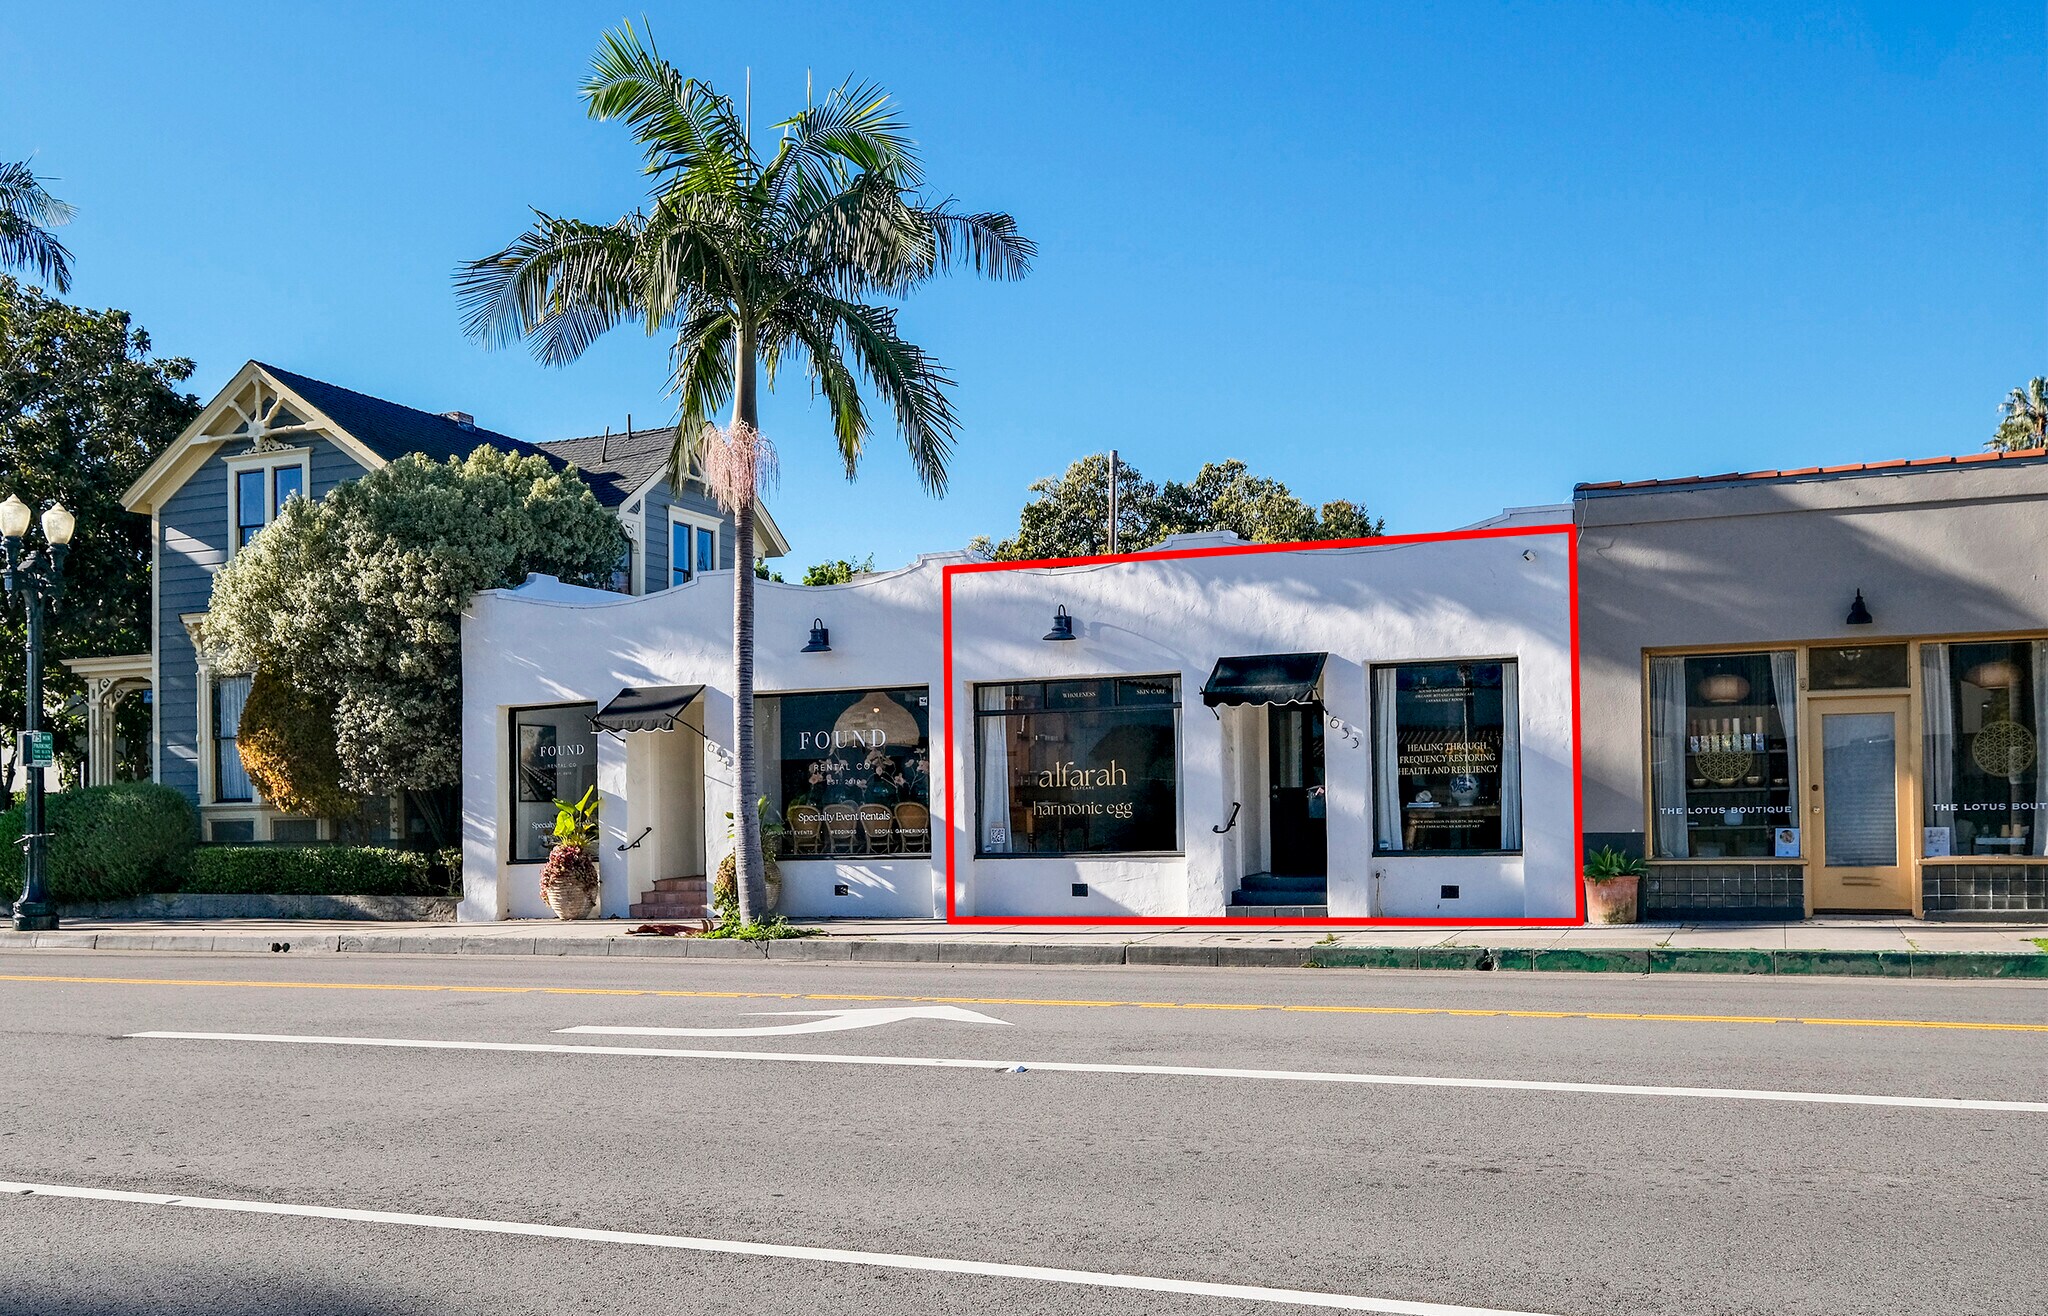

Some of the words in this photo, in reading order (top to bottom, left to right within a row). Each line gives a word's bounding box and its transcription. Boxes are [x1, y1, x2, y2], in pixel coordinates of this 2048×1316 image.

[1330, 716, 1359, 749] 633
[799, 728, 887, 750] FOUND
[540, 744, 585, 757] FOUND
[1407, 743, 1443, 752] HEALING
[1444, 742, 1487, 751] THROUGH
[1400, 755, 1447, 765] FREQUENCY
[1448, 753, 1496, 762] RESTORING
[813, 763, 851, 772] RENTAL
[1398, 767, 1430, 775] HEALTH
[1431, 766, 1450, 774] AND
[1451, 765, 1498, 774] RESILIENCY
[1039, 760, 1127, 788] alfarah
[1033, 800, 1104, 816] harmonic
[1106, 802, 1133, 819] egg
[1660, 807, 1683, 815] THE
[1688, 806, 1726, 814] LOTUS
[1730, 805, 1793, 814] BOUTIQUE
[1933, 803, 1959, 811] THE
[1964, 803, 2007, 811] LOTUS
[2012, 802, 2047, 810] BOUT
[798, 812, 834, 824] Specialty
[836, 811, 858, 821] Event
[860, 810, 891, 820] Rentals
